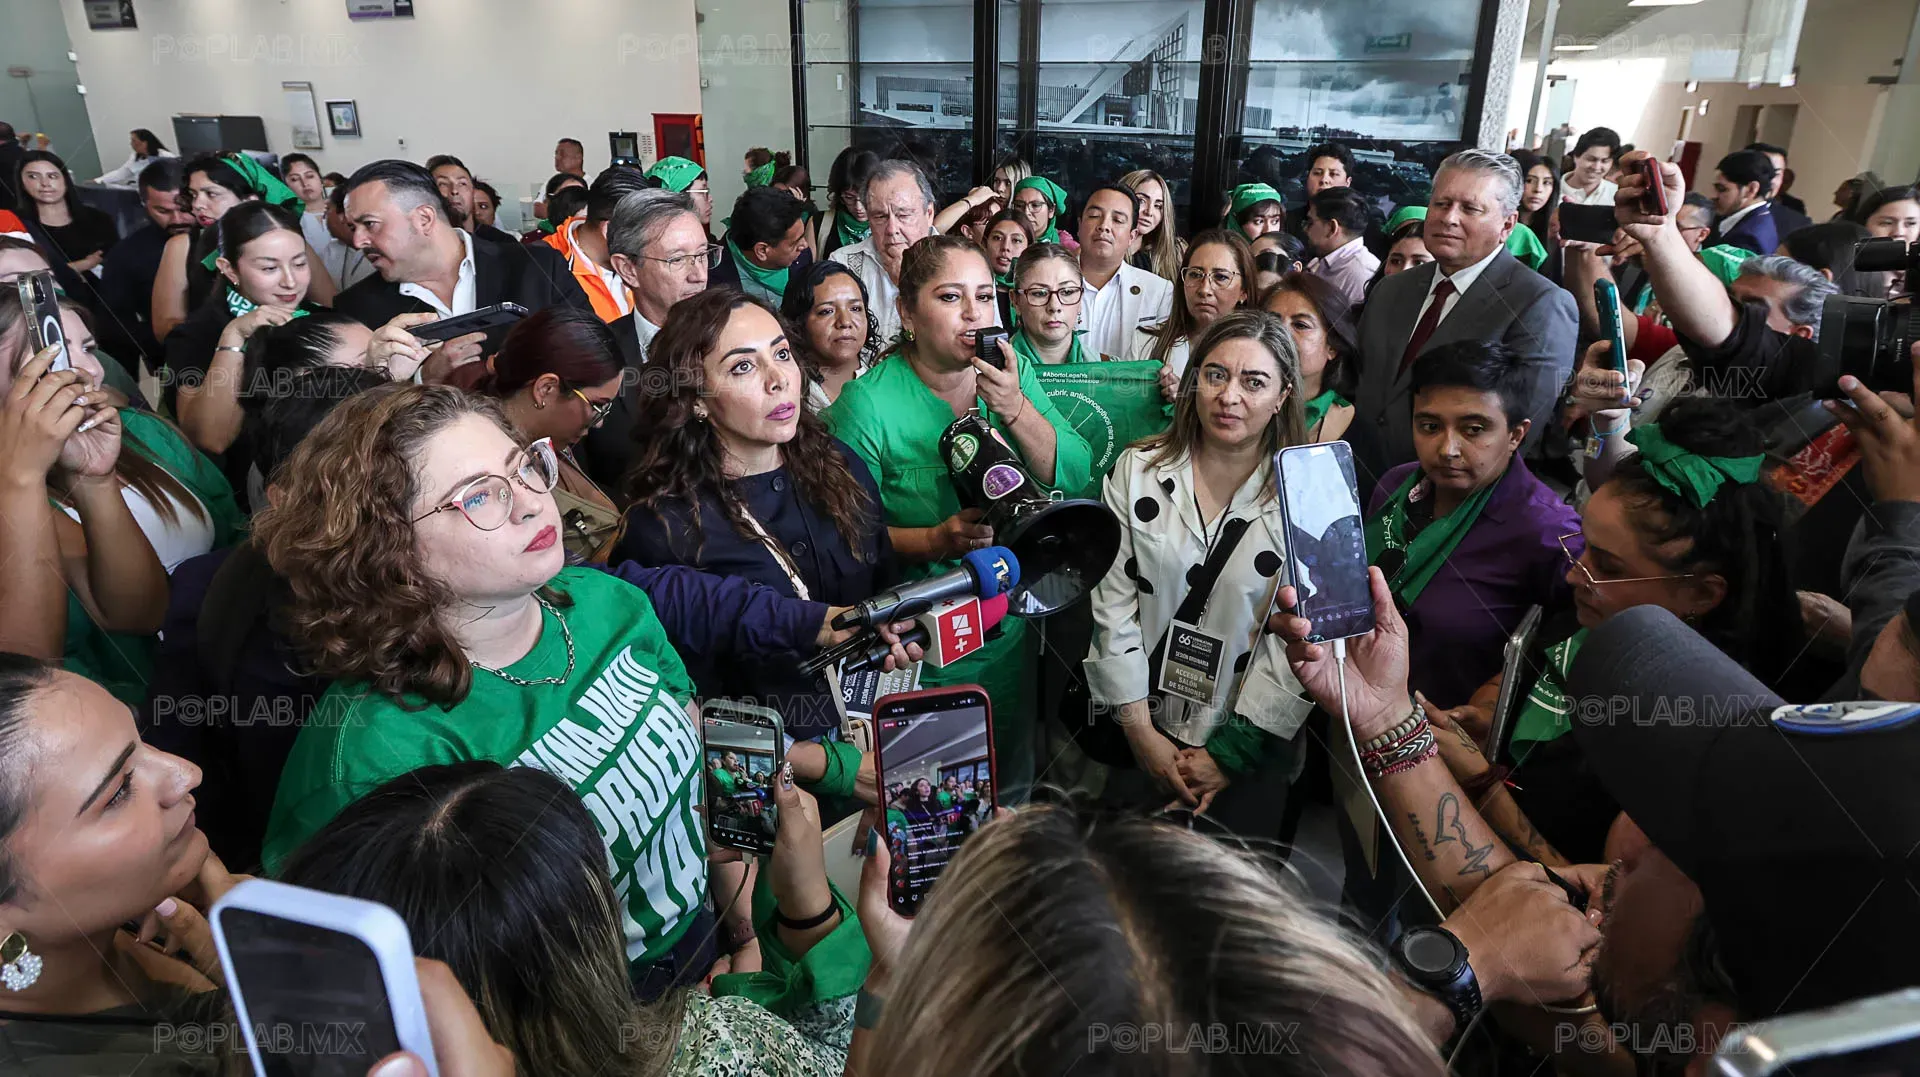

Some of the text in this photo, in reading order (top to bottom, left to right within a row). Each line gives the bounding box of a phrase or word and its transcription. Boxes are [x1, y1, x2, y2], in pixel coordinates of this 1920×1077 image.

[1046, 389, 1069, 398] cubrir,
[1106, 425, 1114, 440] para
[1168, 680, 1206, 699] DE SESIONES
[1175, 668, 1199, 681] ACCESO
[580, 688, 702, 880] PRUEBA
